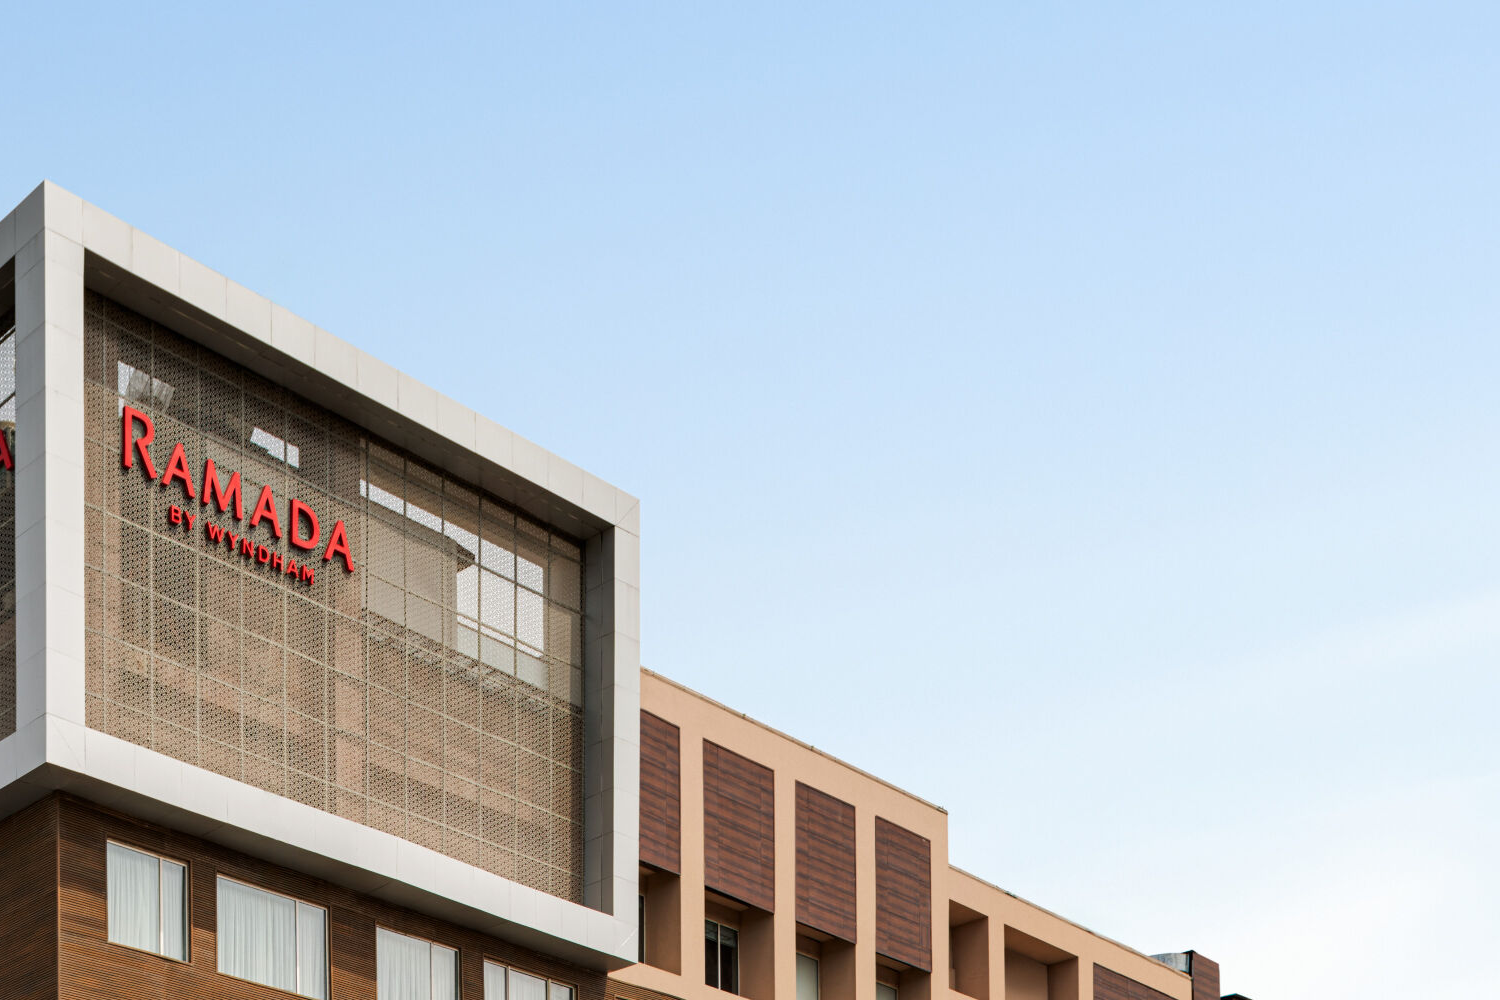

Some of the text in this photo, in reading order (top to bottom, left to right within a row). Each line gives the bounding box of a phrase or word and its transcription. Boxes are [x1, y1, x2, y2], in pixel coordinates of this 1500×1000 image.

[122, 405, 354, 572] RAMADA
[168, 504, 315, 586] BY WYNDHAM
